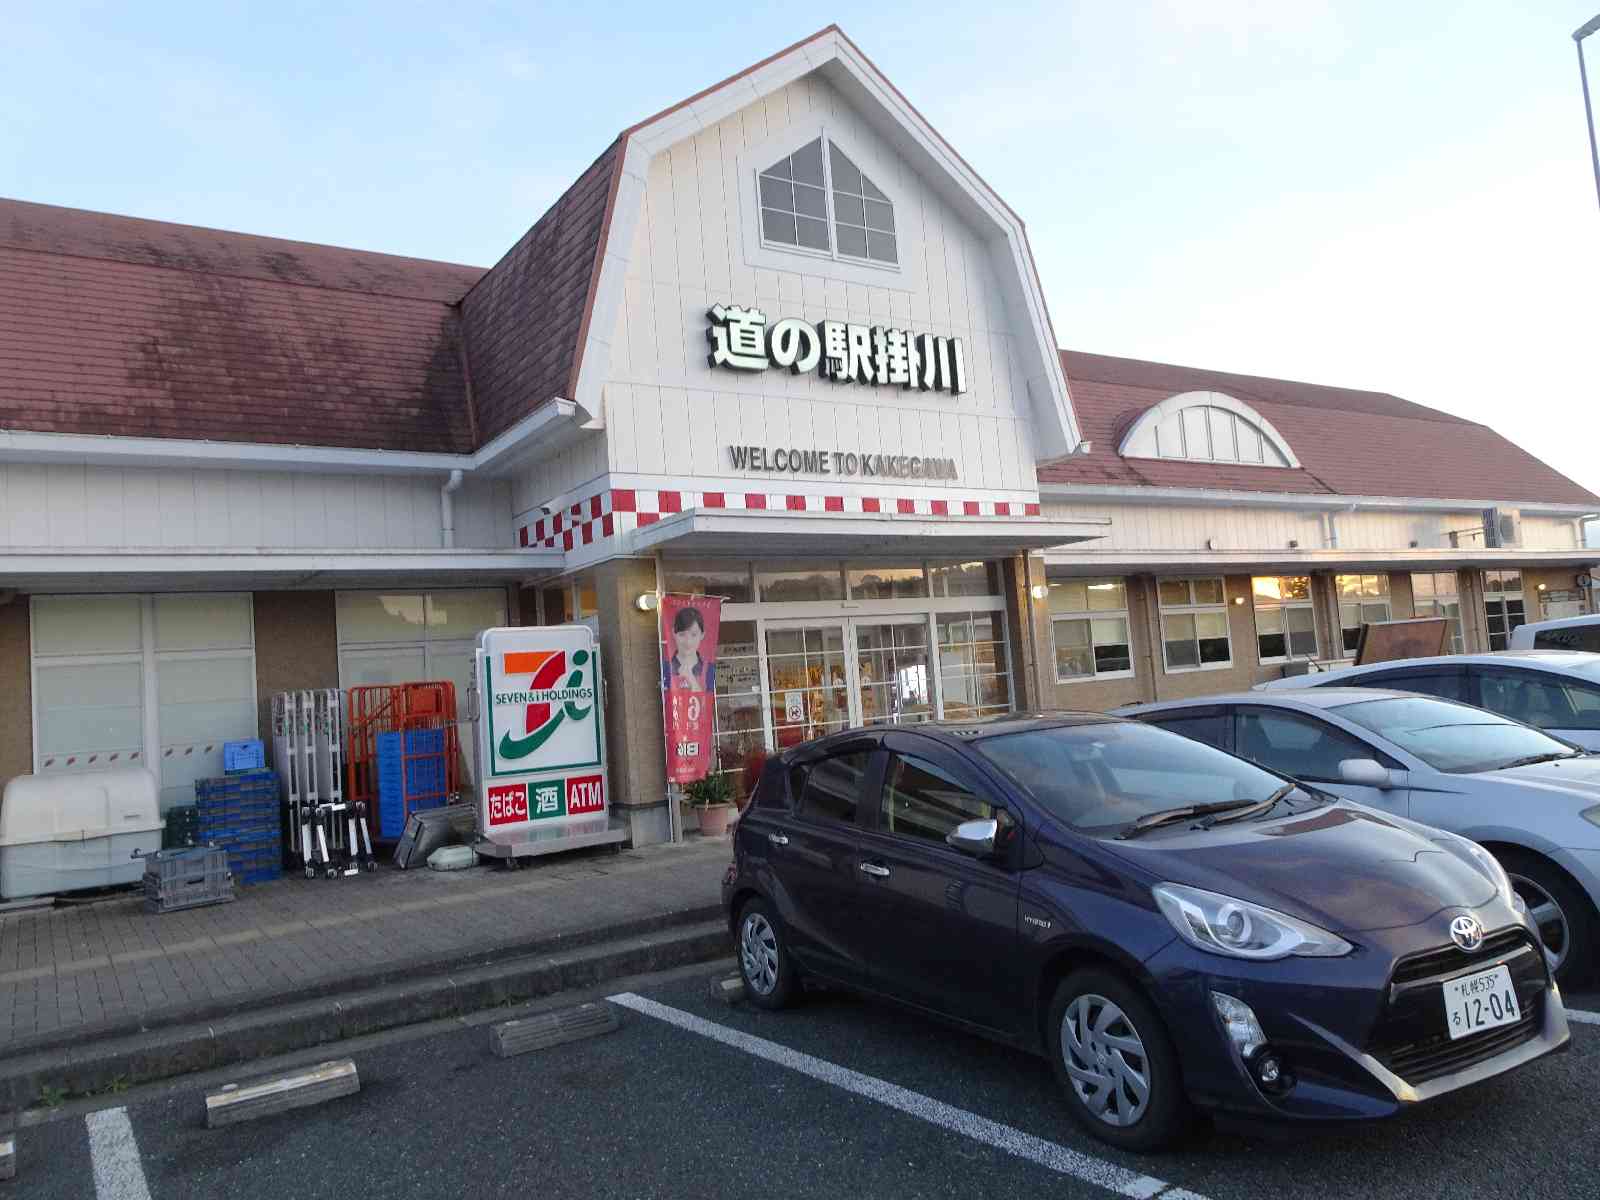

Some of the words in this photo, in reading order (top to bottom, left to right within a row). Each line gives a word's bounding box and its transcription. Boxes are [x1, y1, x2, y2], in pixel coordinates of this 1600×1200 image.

[706, 303, 967, 394] 道の駅掛川
[730, 446, 830, 474] WELCOME
[832, 452, 858, 476] TO
[495, 693, 527, 705] SEVEN
[542, 688, 593, 701] HOLDINGS
[490, 791, 526, 819] たばこ
[536, 786, 559, 814] 酒
[570, 781, 602, 809] ATM
[1465, 990, 1515, 1029] 12-04
